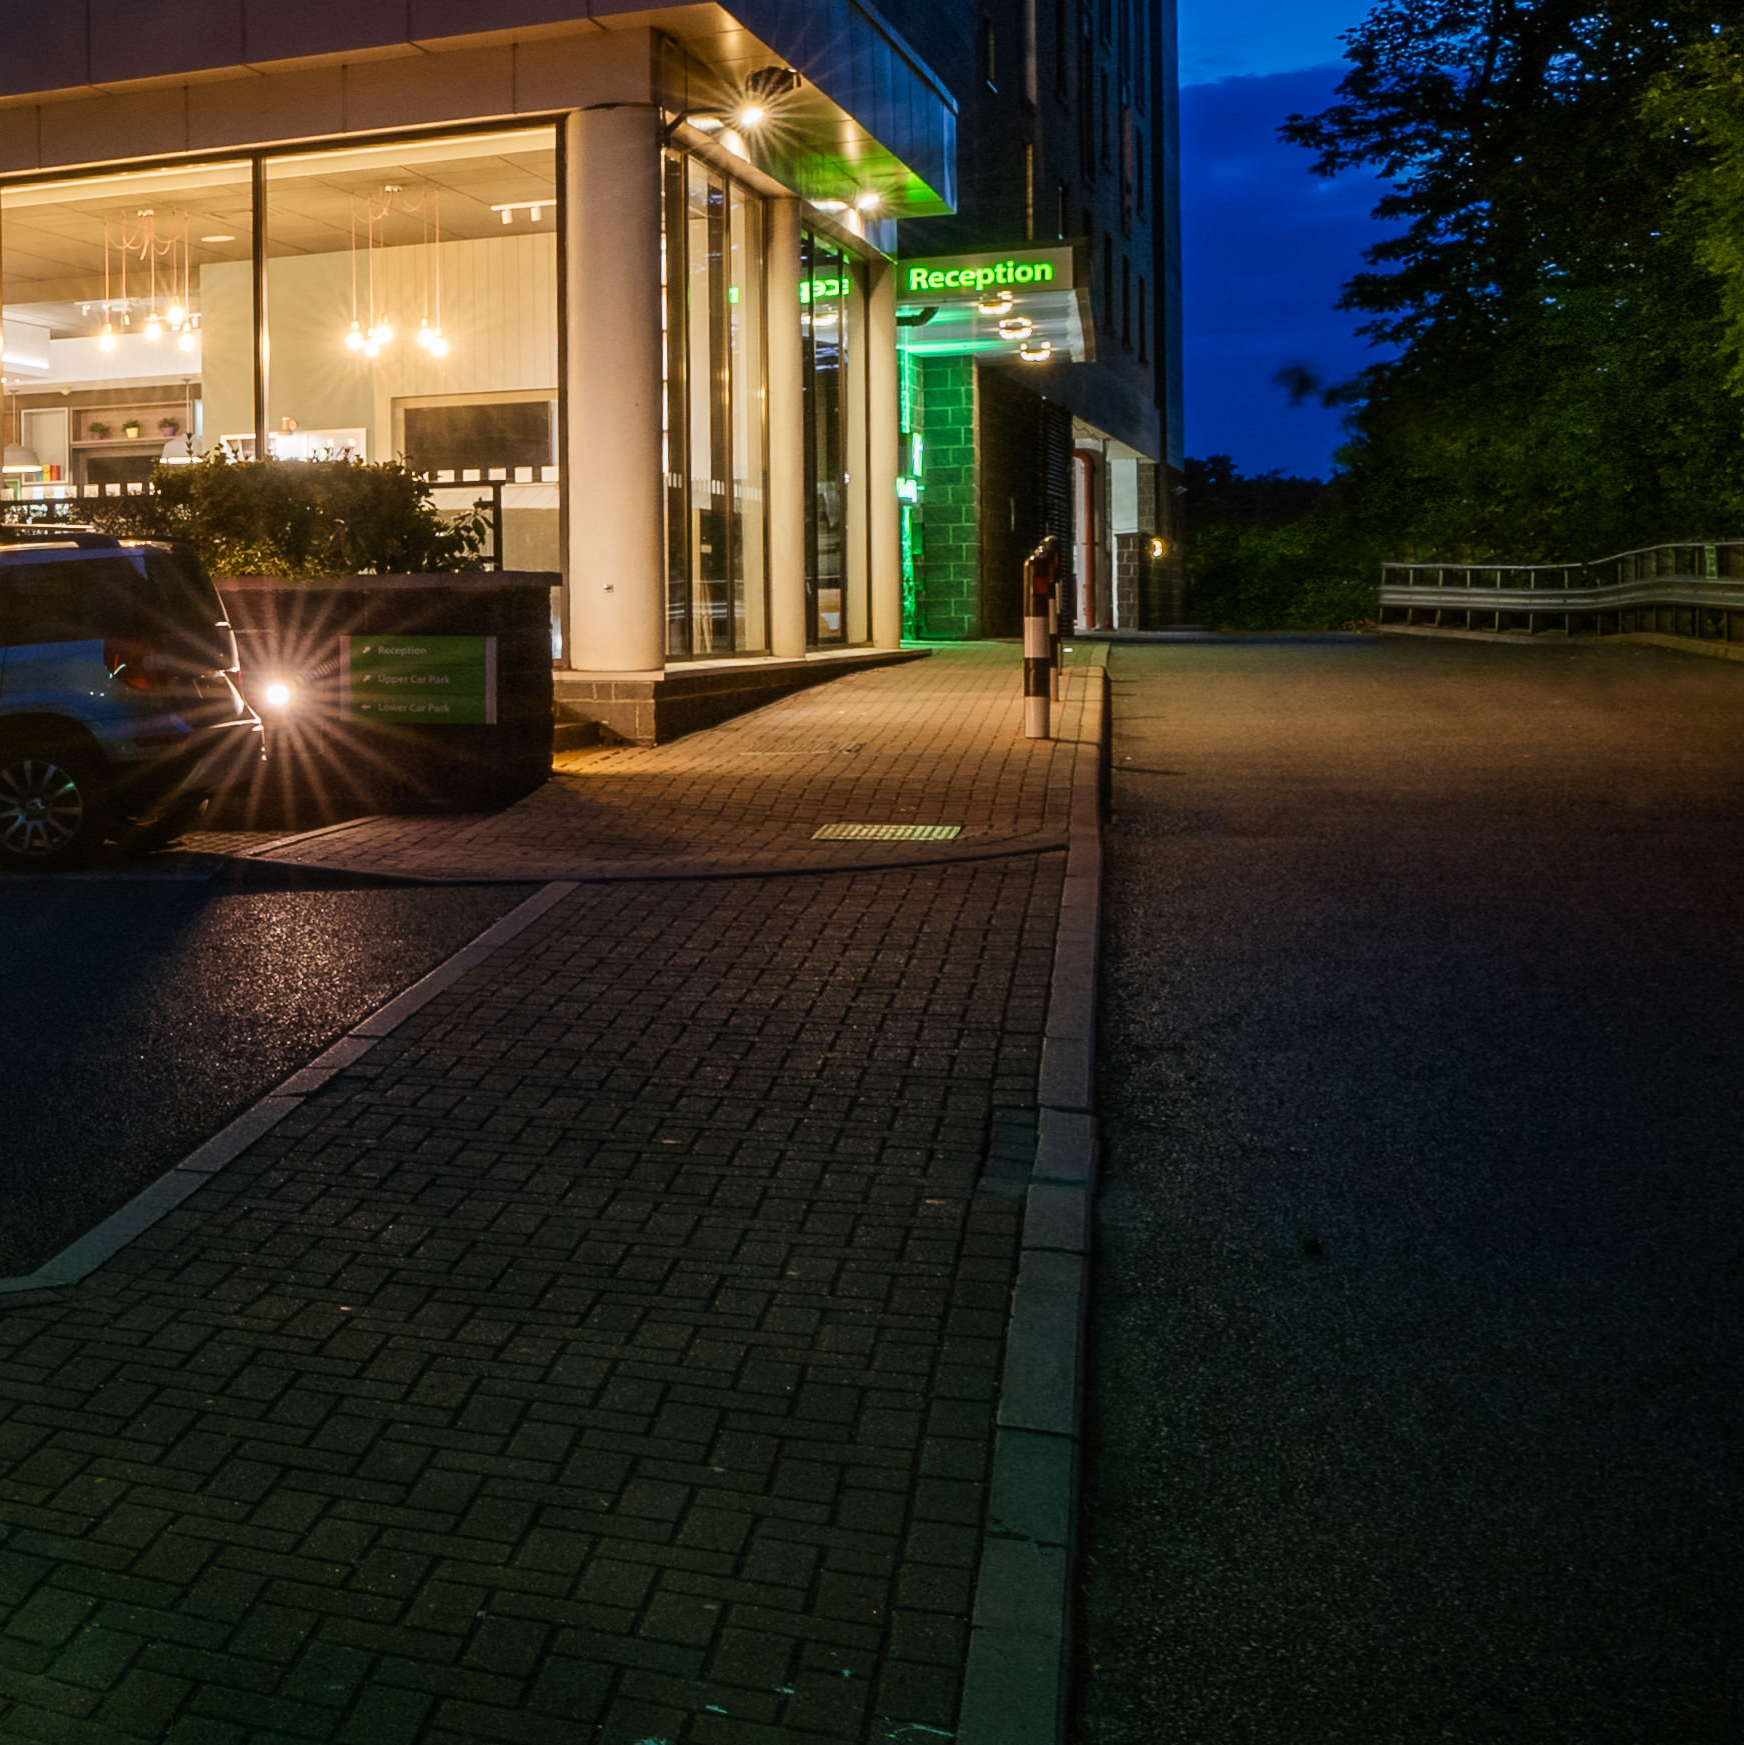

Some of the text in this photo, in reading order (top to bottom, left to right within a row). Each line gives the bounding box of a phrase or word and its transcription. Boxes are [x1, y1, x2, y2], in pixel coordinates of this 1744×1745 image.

[909, 260, 1054, 291] Reception
[378, 646, 427, 656] Reception
[378, 675, 451, 685] Upper Car Park
[378, 703, 450, 713] Lower Car Park
